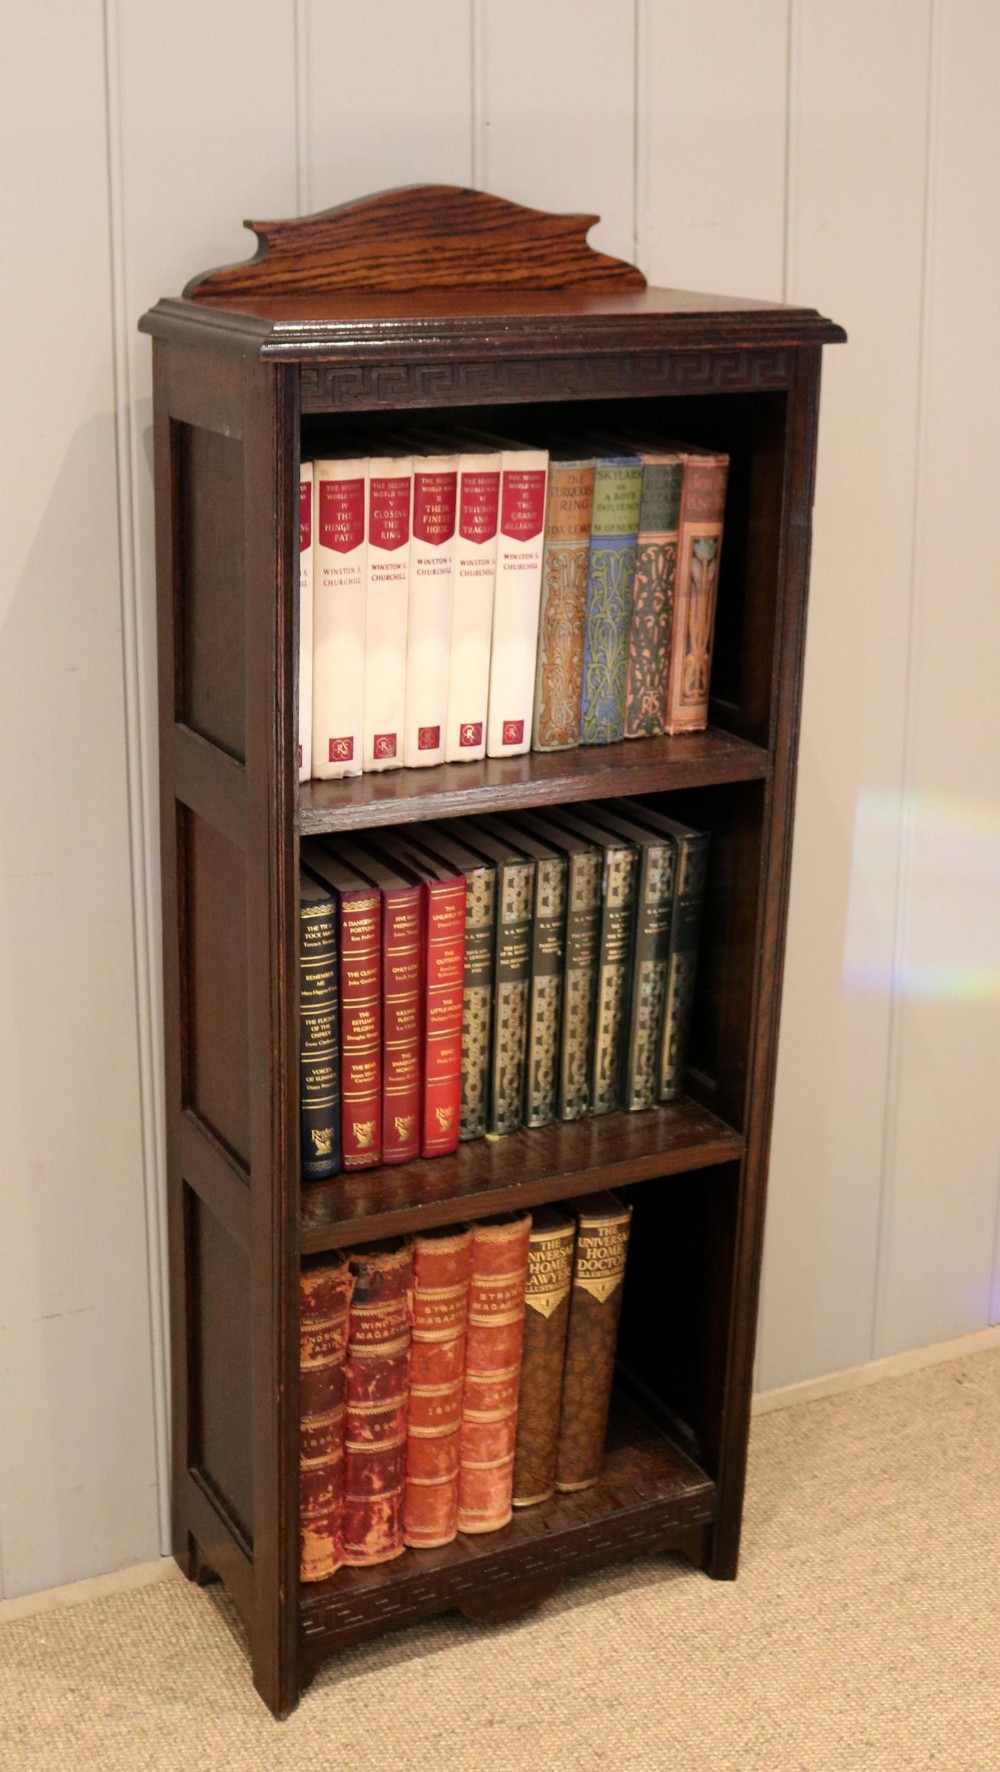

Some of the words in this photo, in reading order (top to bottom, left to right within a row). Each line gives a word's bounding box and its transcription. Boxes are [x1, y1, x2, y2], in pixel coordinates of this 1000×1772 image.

[567, 475, 584, 484] THE
[425, 505, 449, 513] THEIR
[560, 498, 589, 511] RING
[373, 510, 407, 519] CLOSING
[423, 515, 450, 524] FINEST
[473, 515, 489, 524] AND
[325, 523, 350, 532] HINGE
[383, 521, 399, 529] THE
[426, 526, 448, 534] HOUR
[334, 533, 353, 542] FATE
[381, 531, 401, 540] RING
[417, 557, 447, 566] WINSTON
[417, 568, 452, 576] CHURCHILL
[460, 569, 494, 577] CHURCHILL
[323, 578, 361, 587] CHURCHILL
[371, 574, 406, 582] CHURCHILL
[430, 1006, 447, 1015] LITTLE
[317, 1015, 336, 1025] FLIGHT
[311, 1031, 332, 1039] OSPREY
[598, 1227, 619, 1237] THE
[541, 1240, 560, 1251] THE
[528, 1244, 573, 1263] NIVERSAL
[586, 1244, 624, 1259] HOME
[529, 1259, 567, 1274] HOME
